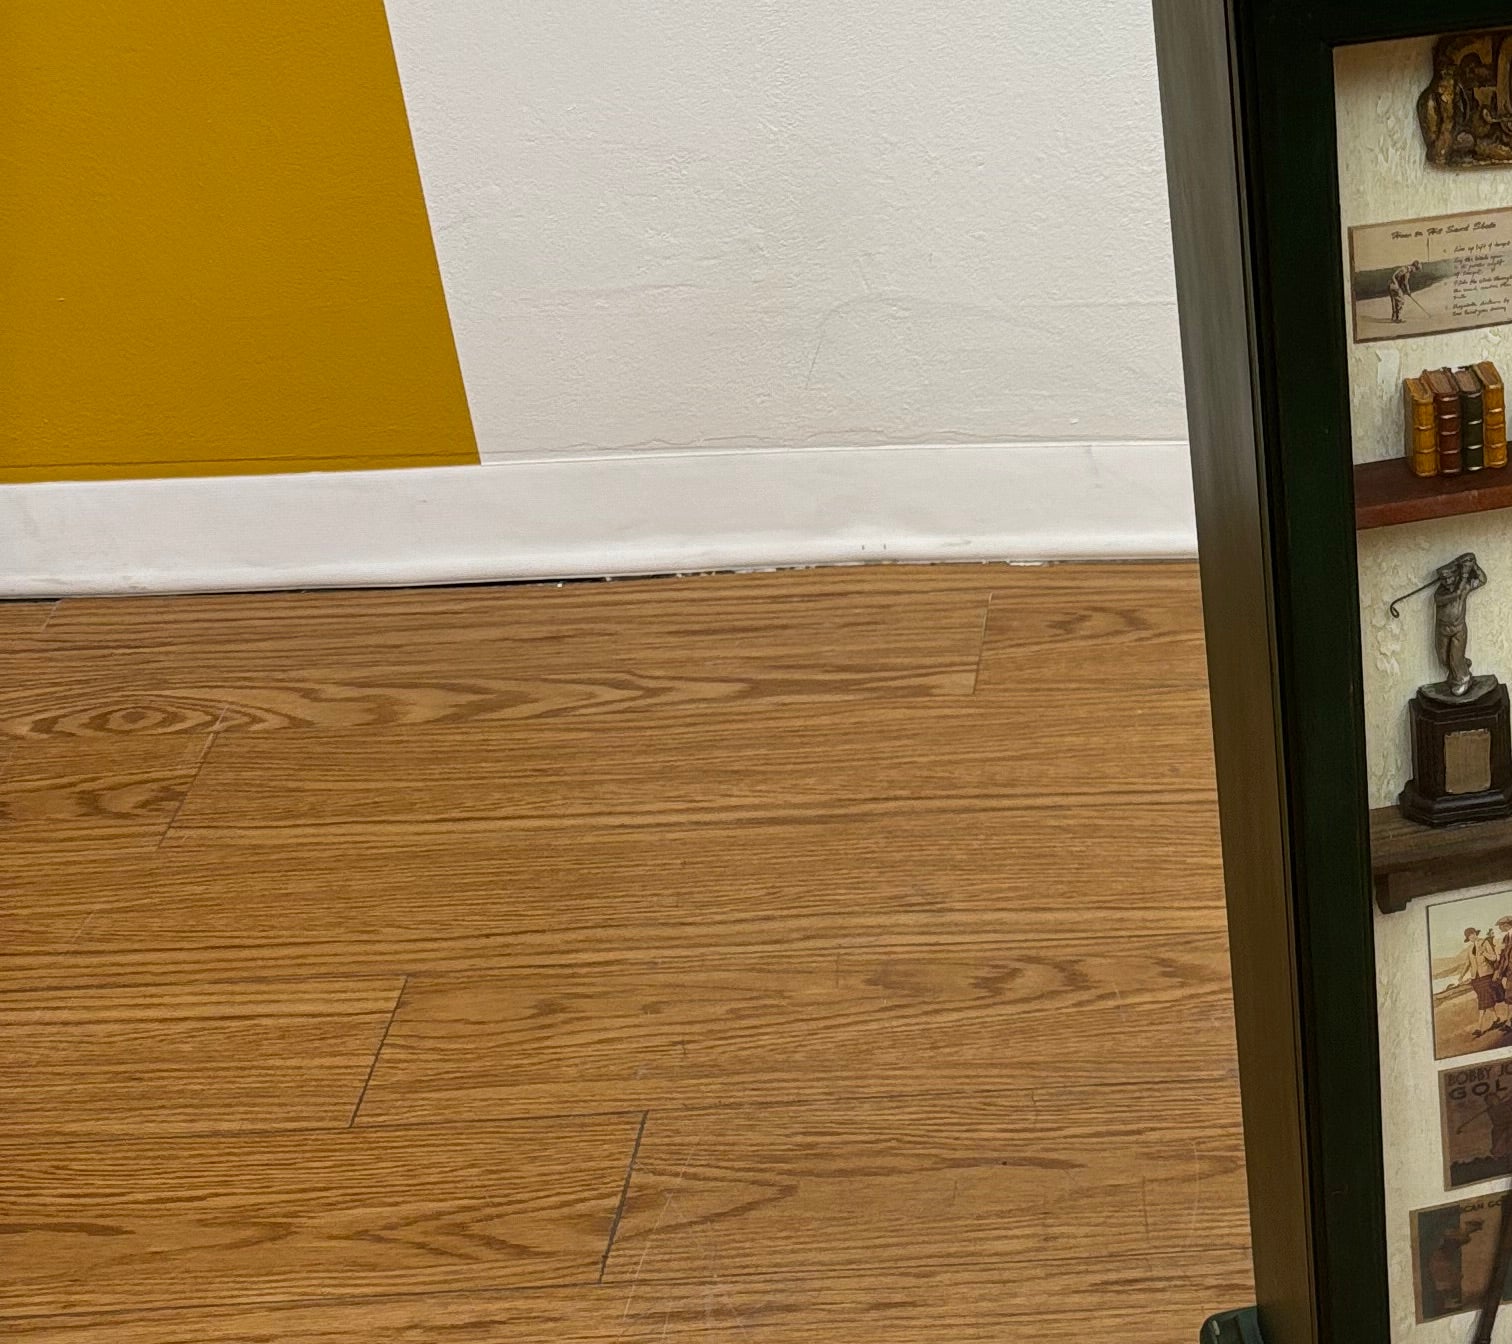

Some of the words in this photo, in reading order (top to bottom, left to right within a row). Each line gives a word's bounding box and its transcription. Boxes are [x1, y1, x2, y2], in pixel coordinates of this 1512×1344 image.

[1445, 223, 1470, 234] Sand
[1472, 221, 1497, 232] Shots
[1446, 1067, 1492, 1086] BOBBY
